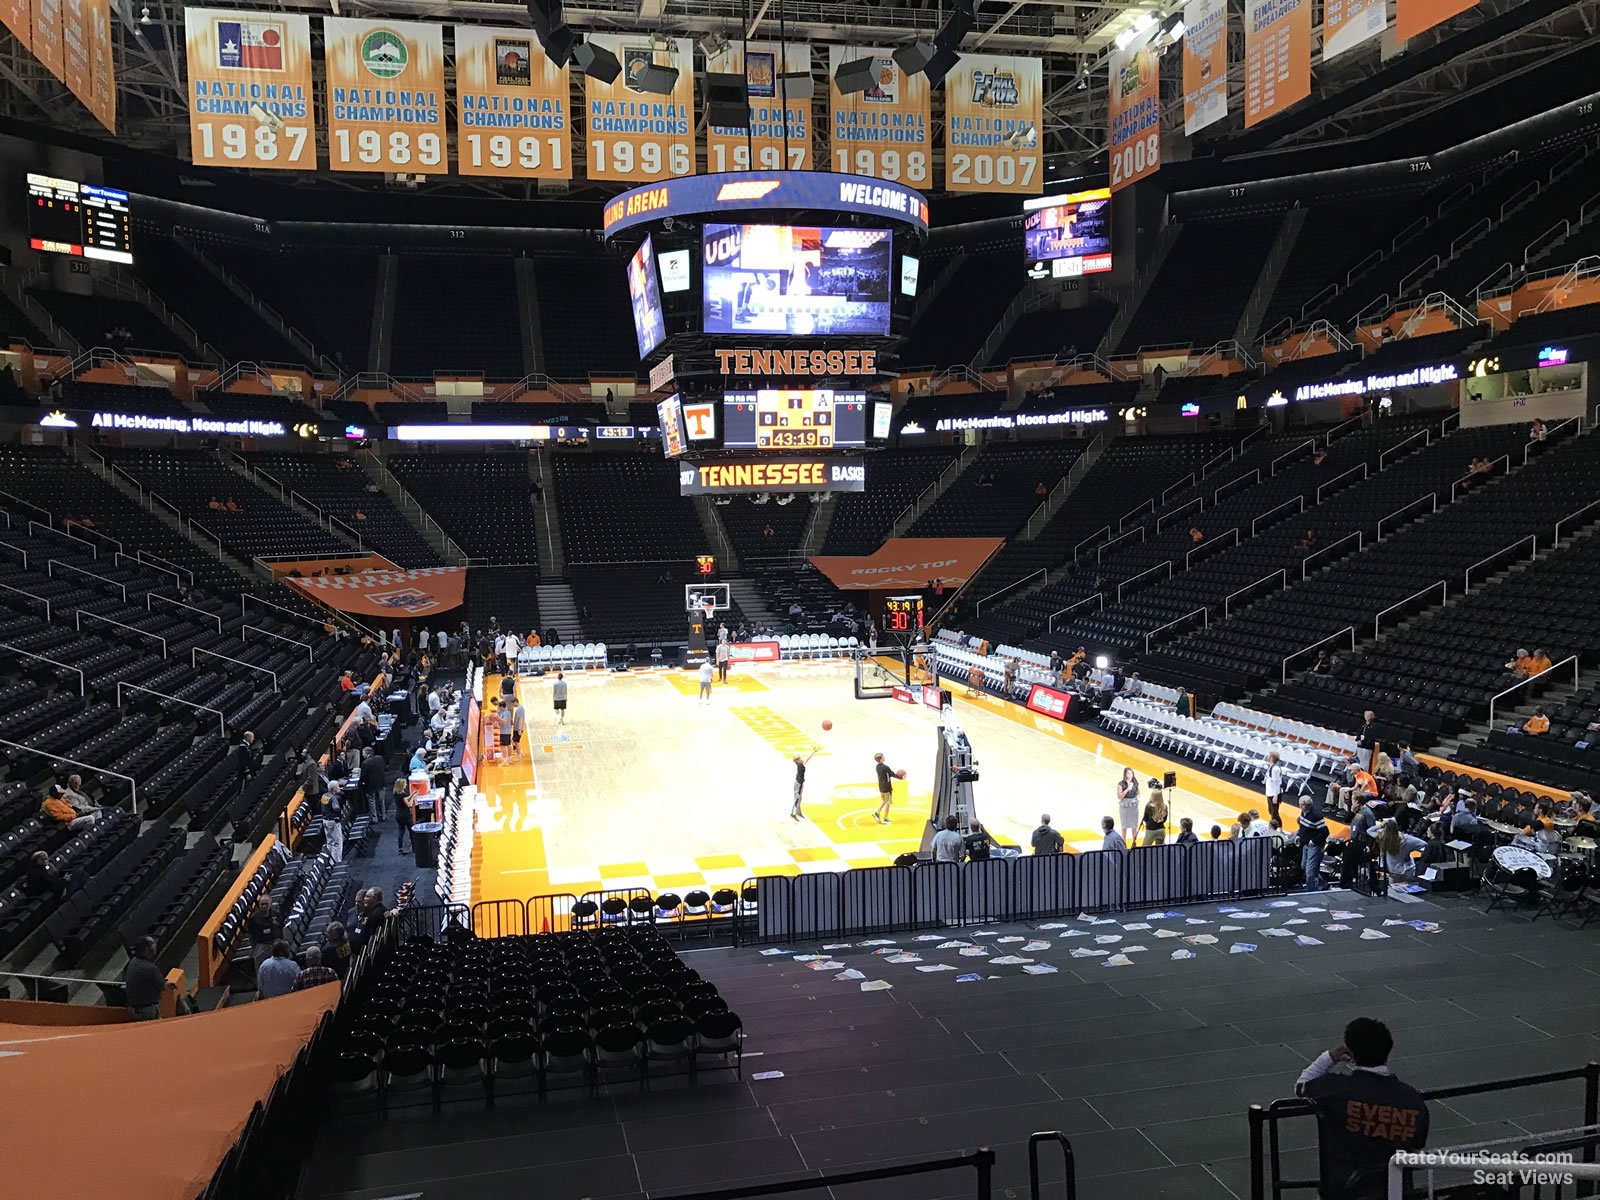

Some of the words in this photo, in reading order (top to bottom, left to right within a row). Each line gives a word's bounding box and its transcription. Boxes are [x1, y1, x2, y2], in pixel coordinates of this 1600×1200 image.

[195, 80, 306, 101] NATIONAL
[334, 87, 438, 107] NATIONAL
[334, 104, 439, 124] CHAMPIONS
[463, 95, 564, 113] NATIONAL
[591, 100, 688, 119] NATIONAL
[1112, 96, 1158, 132] NATIONAL
[1576, 103, 1593, 116] 318
[463, 111, 565, 130] CHAMPIONS
[591, 117, 689, 135] CHAMPIONS
[750, 108, 806, 124] IONAL
[836, 110, 925, 127] NATIONAL
[836, 126, 926, 143] CHAMPIONS
[1112, 110, 1158, 147] CHAMPIONS
[198, 122, 308, 161] 1987
[335, 129, 441, 166] 1989
[951, 131, 1037, 149] CHAMPS
[467, 134, 562, 170] 1991
[592, 139, 690, 175] 1996
[713, 144, 806, 171] 1997
[1112, 133, 1158, 186] 2008
[836, 149, 926, 182] 1998
[952, 153, 1037, 186] 2007
[1409, 161, 1433, 173] 317A
[626, 187, 669, 217] ARENA
[840, 182, 907, 213] WELCOME
[909, 195, 919, 217] TO
[1229, 188, 1246, 198] 317
[449, 230, 465, 239] 312
[715, 349, 876, 375] TENNESSEE
[1296, 386, 1309, 401] All
[1310, 378, 1367, 400] McMorning,
[1368, 373, 1397, 391] Noon
[1397, 368, 1419, 387] and
[1419, 364, 1458, 384] Night.
[91, 413, 112, 428] All
[114, 414, 191, 433] McMorning,
[192, 418, 225, 432] Noon
[225, 421, 248, 433] and
[249, 421, 285, 435] Night.
[686, 408, 711, 435] T
[764, 414, 772, 424] 0
[819, 414, 827, 423] 0
[936, 419, 951, 431] All
[952, 415, 1015, 431] McMorning,
[1016, 413, 1047, 425] Noon
[1047, 411, 1070, 424] and
[1071, 409, 1109, 423] Night.
[602, 428, 628, 437] 43:19
[774, 432, 816, 446] 43:19
[699, 463, 825, 487] TENNESSEE
[700, 562, 711, 573] 30
[851, 563, 918, 576] ROCKY
[920, 559, 958, 570] TOP
[886, 601, 910, 611] 43:19
[692, 624, 702, 634] T
[891, 612, 907, 630] 30
[1345, 1100, 1419, 1124] EVENT
[1345, 1118, 1416, 1142] STAFF
